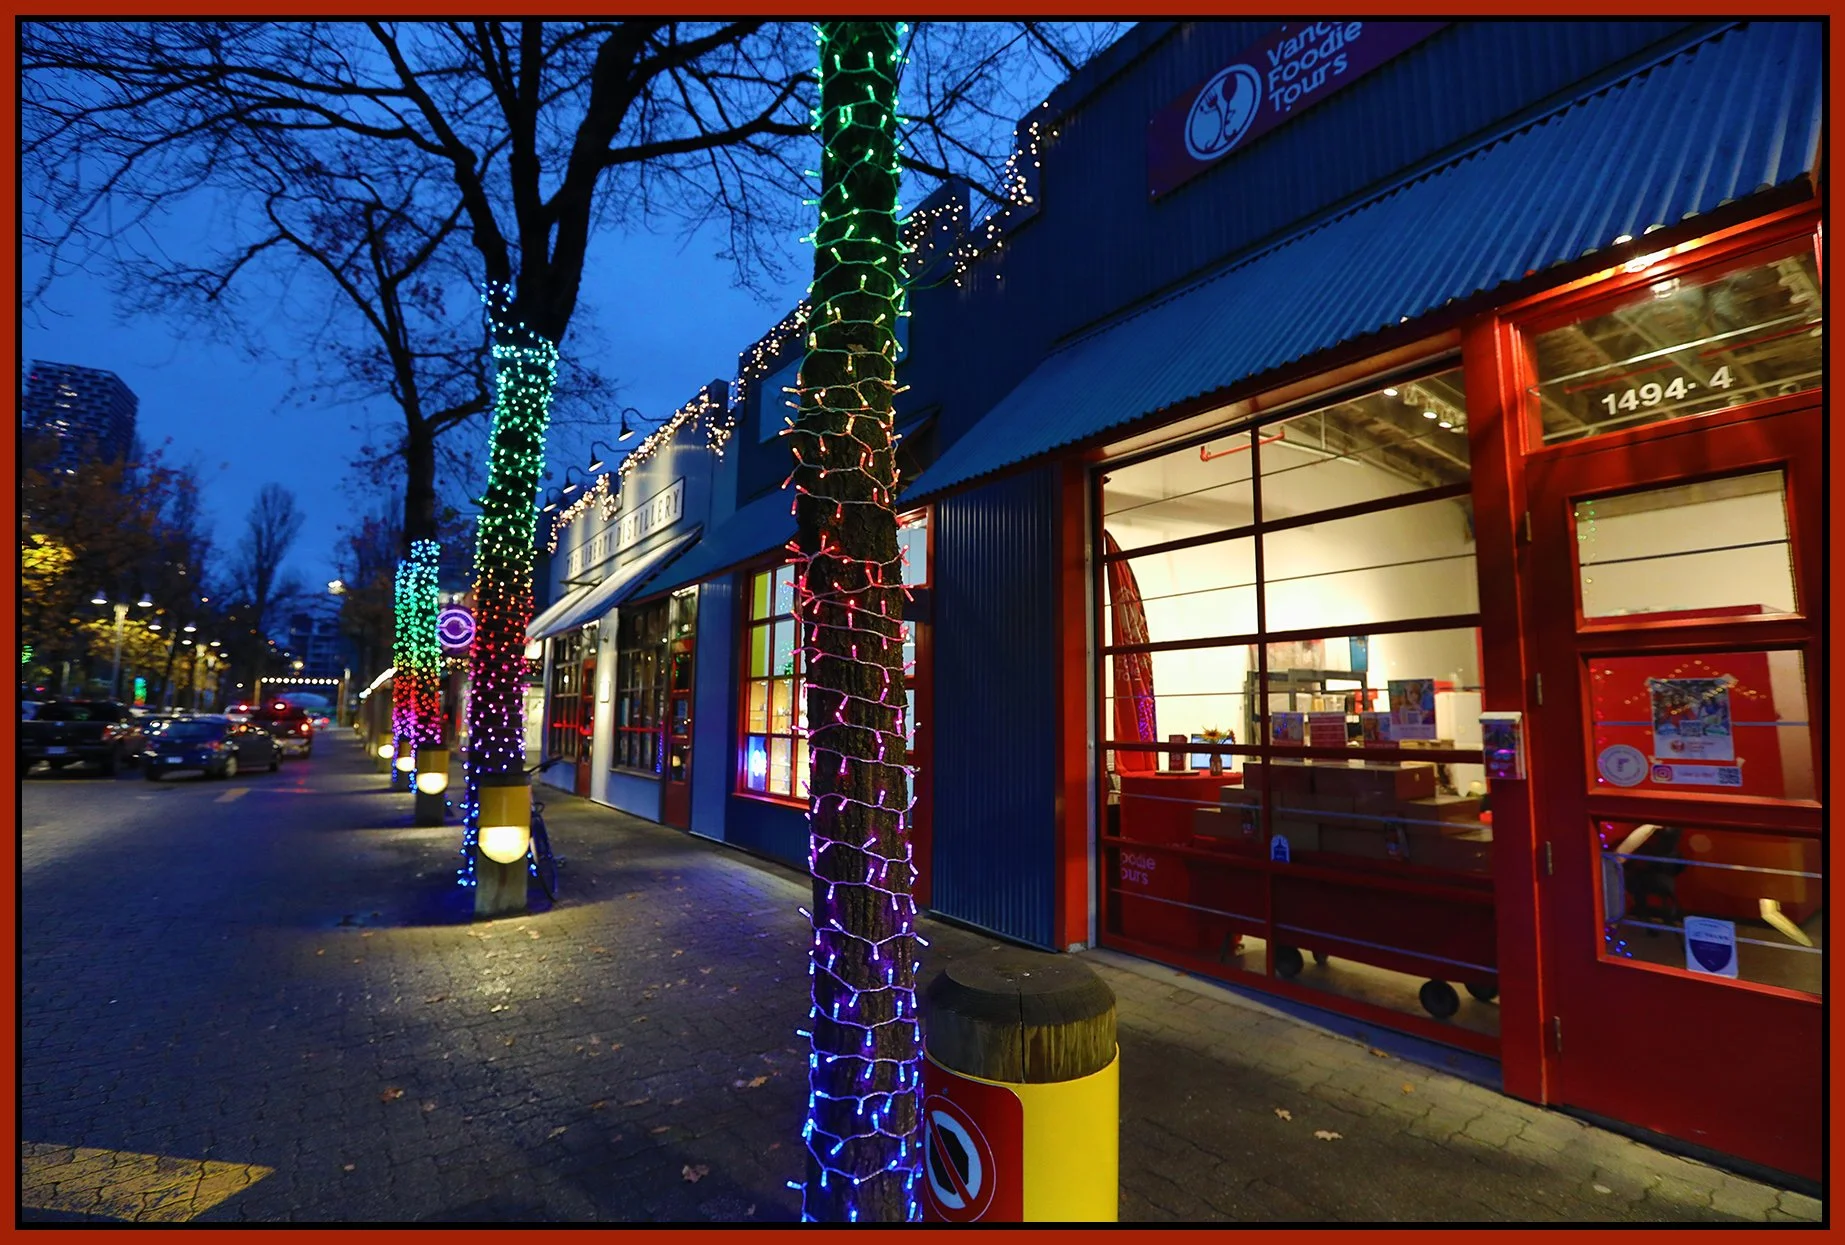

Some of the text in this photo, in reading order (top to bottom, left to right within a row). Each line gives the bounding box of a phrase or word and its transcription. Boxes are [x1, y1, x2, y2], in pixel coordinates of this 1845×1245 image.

[1266, 22, 1343, 66] Vanc
[1267, 22, 1362, 91] Foodie
[1269, 52, 1348, 112] Tours
[1708, 365, 1735, 389] 4
[616, 489, 680, 547] DISTILLERY
[1119, 851, 1156, 871] oodie
[1119, 867, 1148, 885] ours
